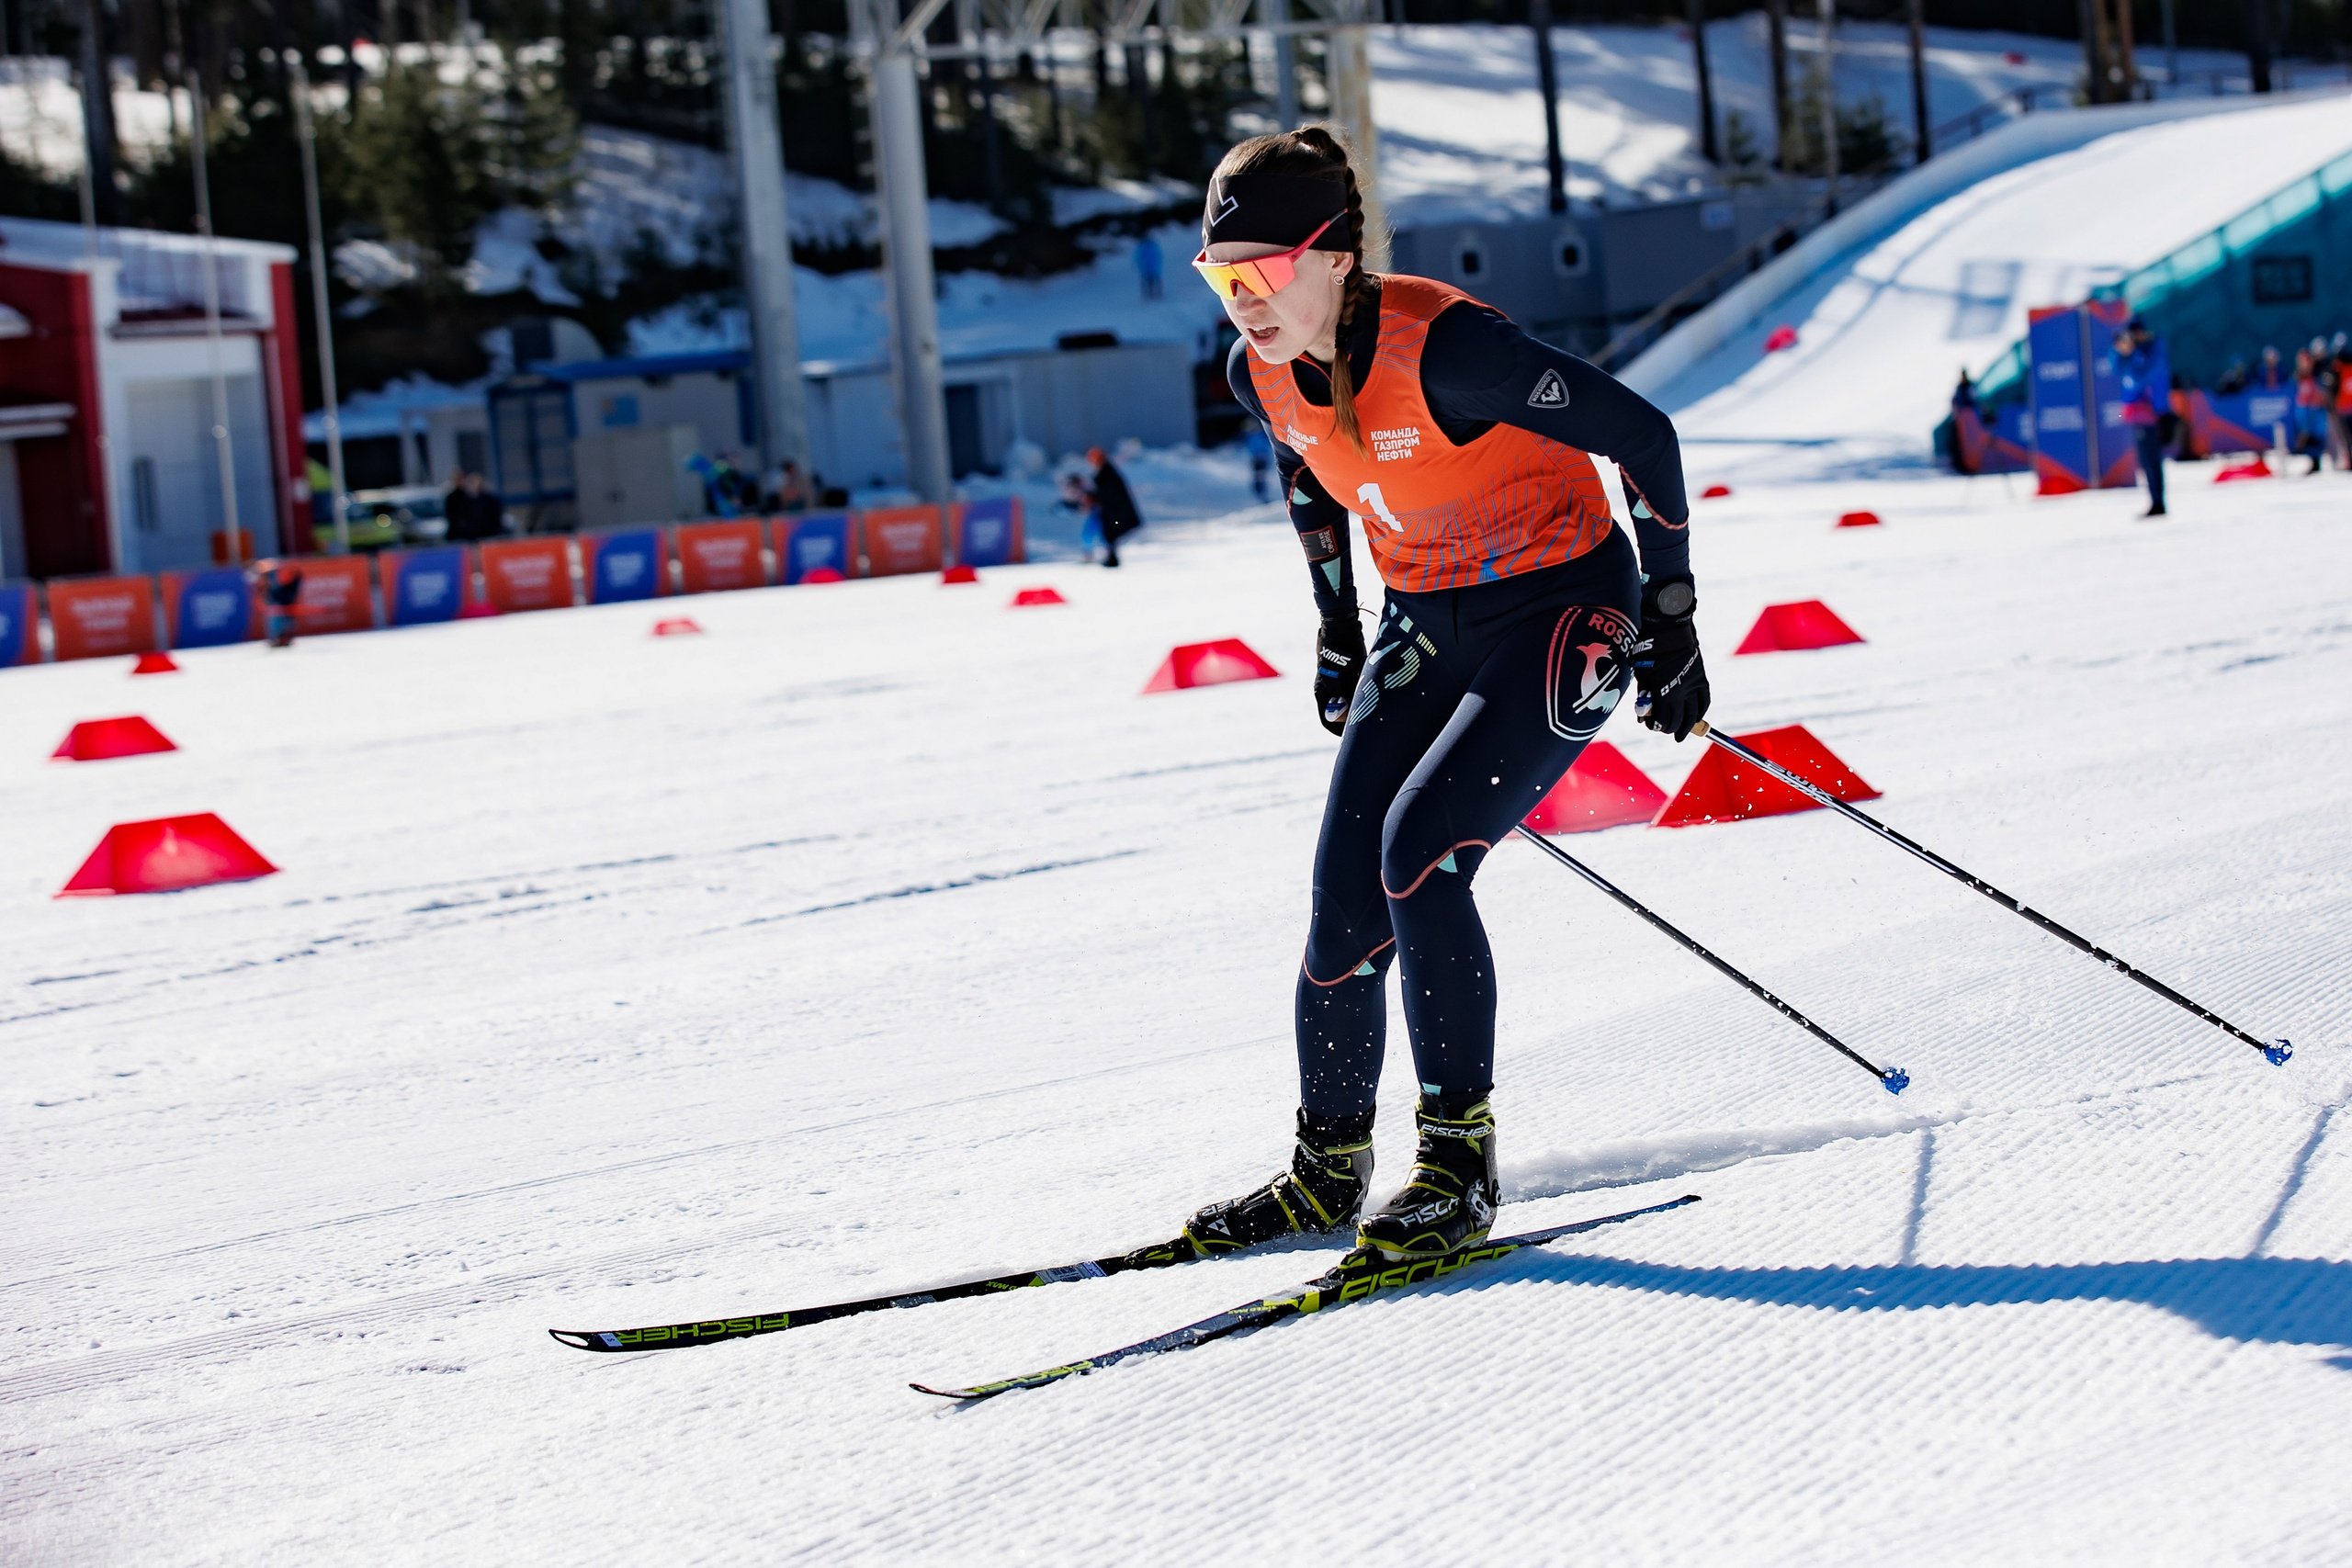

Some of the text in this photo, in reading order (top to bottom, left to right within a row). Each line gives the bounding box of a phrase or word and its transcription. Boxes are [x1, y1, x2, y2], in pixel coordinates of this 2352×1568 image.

[1532, 375, 1554, 402] ROSSIGNOL
[1371, 426, 1420, 441] КОМАНДА
[1374, 436, 1420, 452] ГАЗПРОМ
[1376, 447, 1413, 462] НЕФТИ
[1356, 482, 1404, 533] 1
[1420, 1123, 1490, 1137] FISCHER
[615, 1313, 789, 1344] FISCHER
